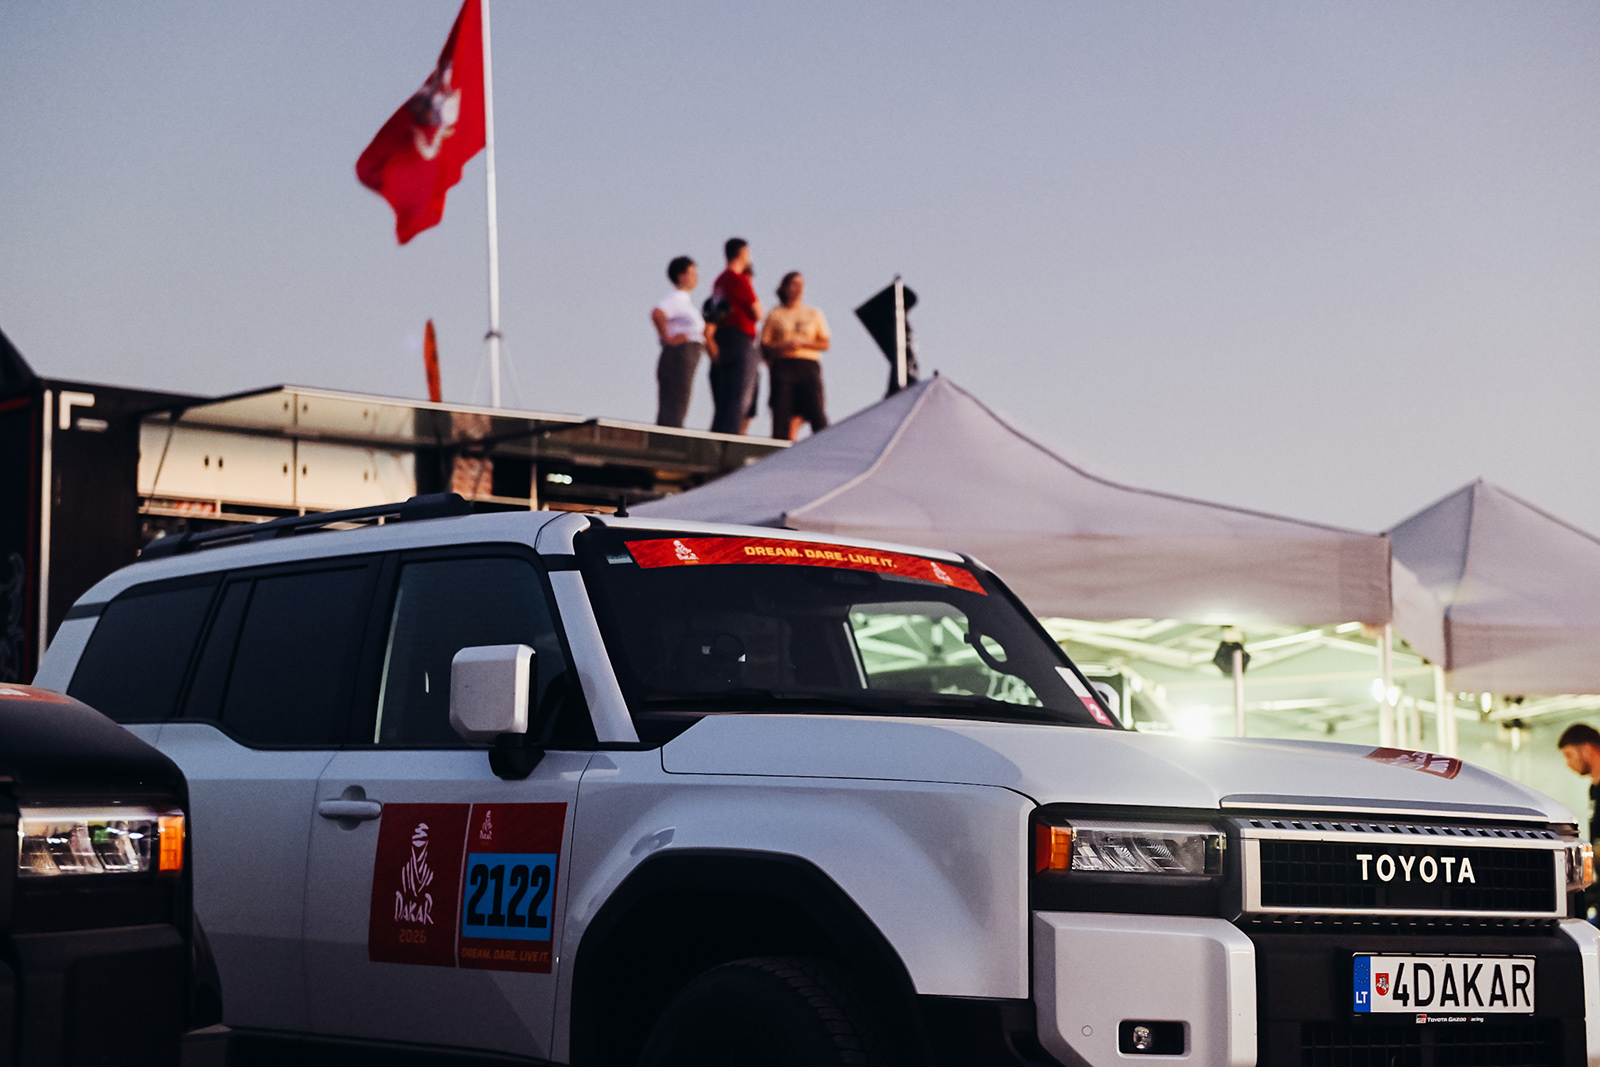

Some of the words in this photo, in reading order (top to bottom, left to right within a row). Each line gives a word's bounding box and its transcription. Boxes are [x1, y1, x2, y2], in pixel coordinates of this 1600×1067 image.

[744, 546, 803, 557] DREAM.
[804, 549, 848, 562] DARE.
[848, 553, 880, 566] LIVE
[880, 558, 898, 569] IT.
[1089, 703, 1106, 720] 2
[1356, 854, 1476, 884] TOYOTA
[394, 890, 434, 925] DAKAR
[466, 864, 551, 928] 2122
[399, 929, 427, 944] 2026
[461, 947, 492, 959] DREAM.
[493, 949, 518, 961] DARE.
[519, 951, 539, 962] LIVE
[1392, 962, 1531, 1007] 4DAKAR
[1355, 991, 1368, 1004] LT
